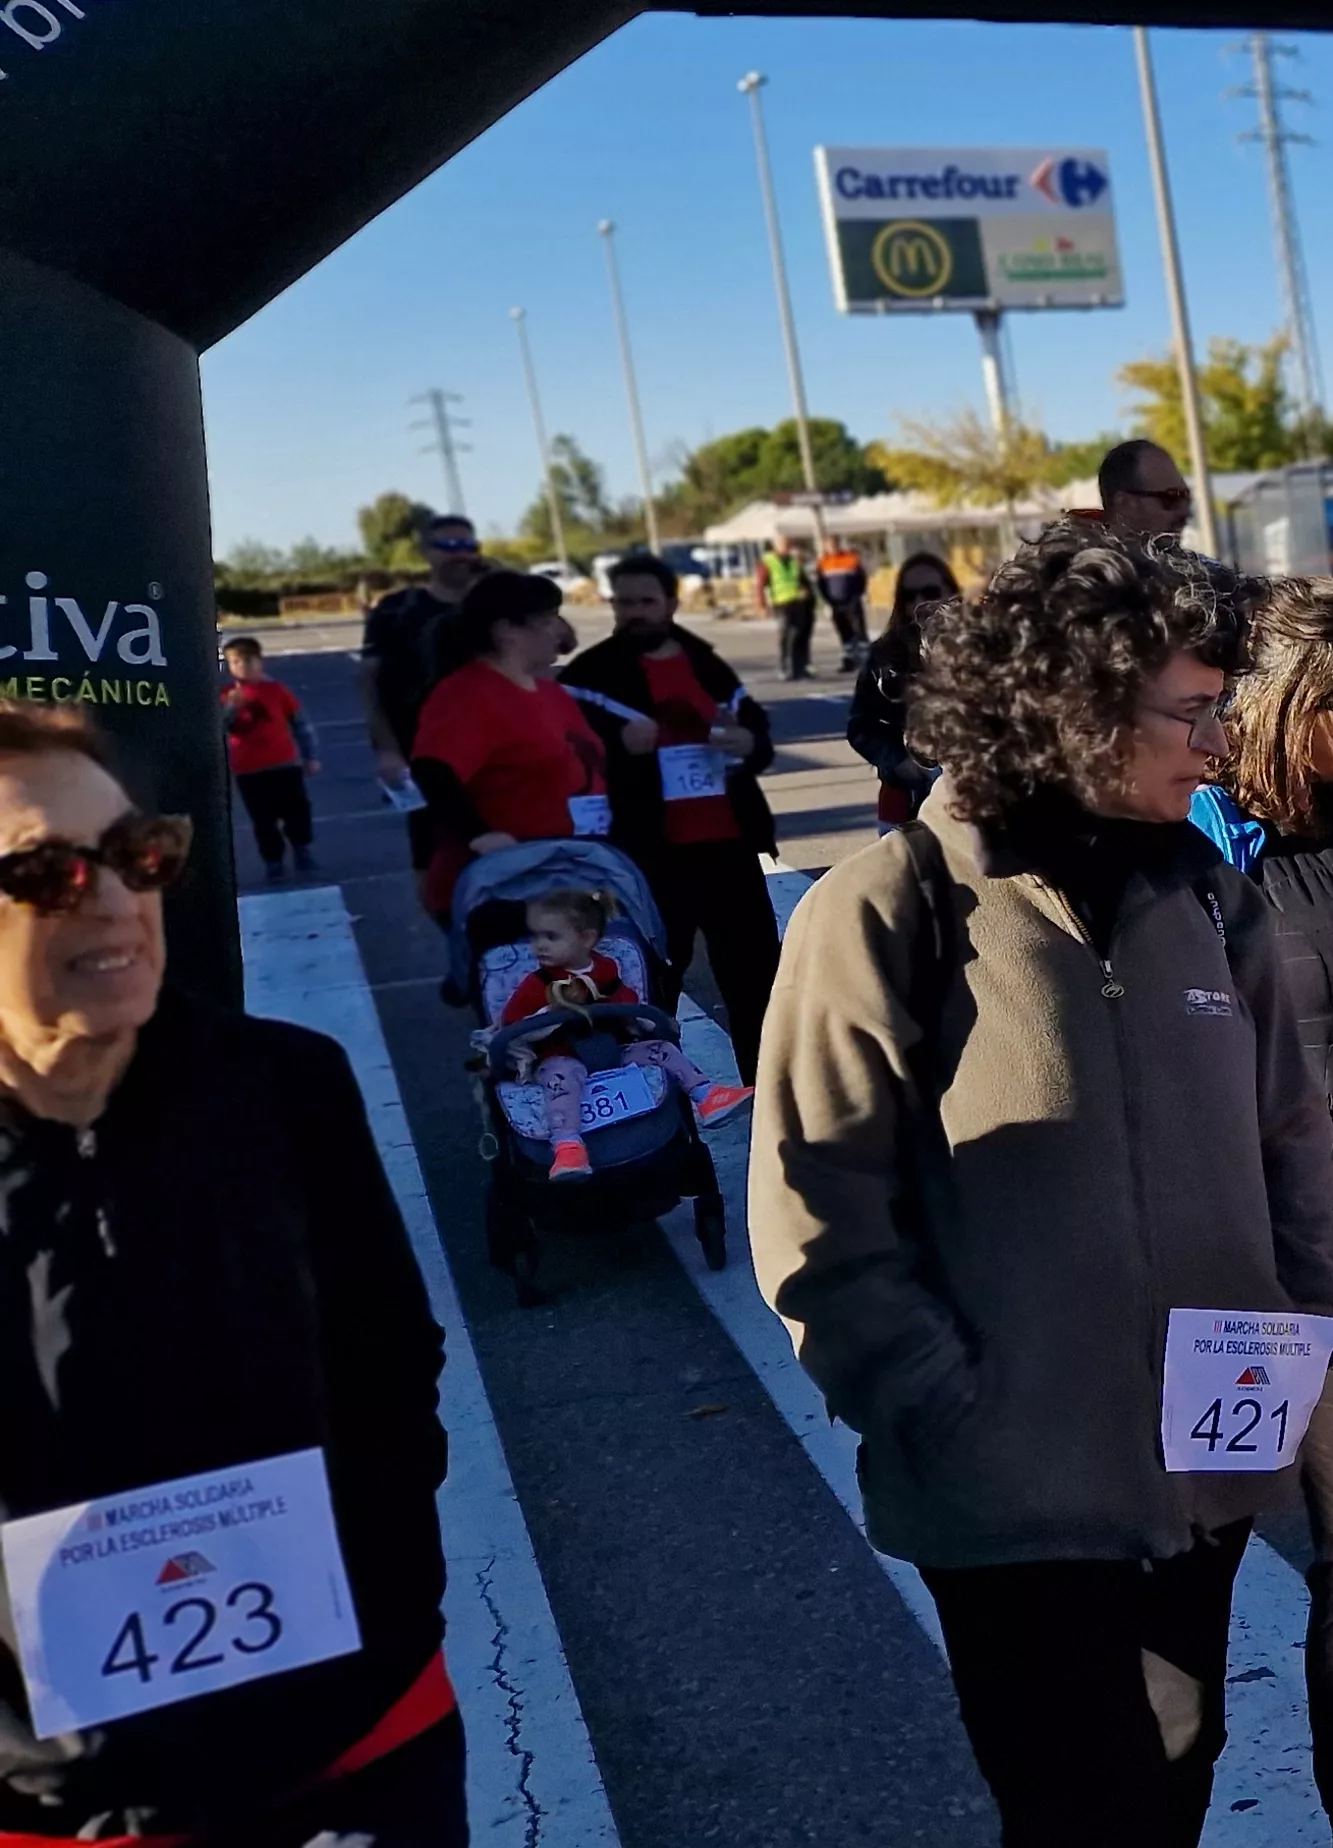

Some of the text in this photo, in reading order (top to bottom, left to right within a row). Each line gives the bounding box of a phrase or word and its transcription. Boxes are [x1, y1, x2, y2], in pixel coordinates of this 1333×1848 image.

[835, 165, 1020, 200] Carrefour
[580, 1091, 629, 1124] 381
[1194, 1339, 1213, 1353] POR
[1213, 1340, 1224, 1353] LA
[1226, 1341, 1278, 1356] ESCLEROSIS
[1213, 1321, 1300, 1336] III MARCHA SOLIDARIA
[1190, 1398, 1289, 1453] 421
[105, 1496, 173, 1527] MARCHA
[173, 1478, 255, 1511] SOLIDARIA
[59, 1542, 94, 1569] POR
[96, 1537, 120, 1558] LA
[120, 1513, 217, 1552] ESCLEROSIS
[101, 1582, 283, 1684] 423
